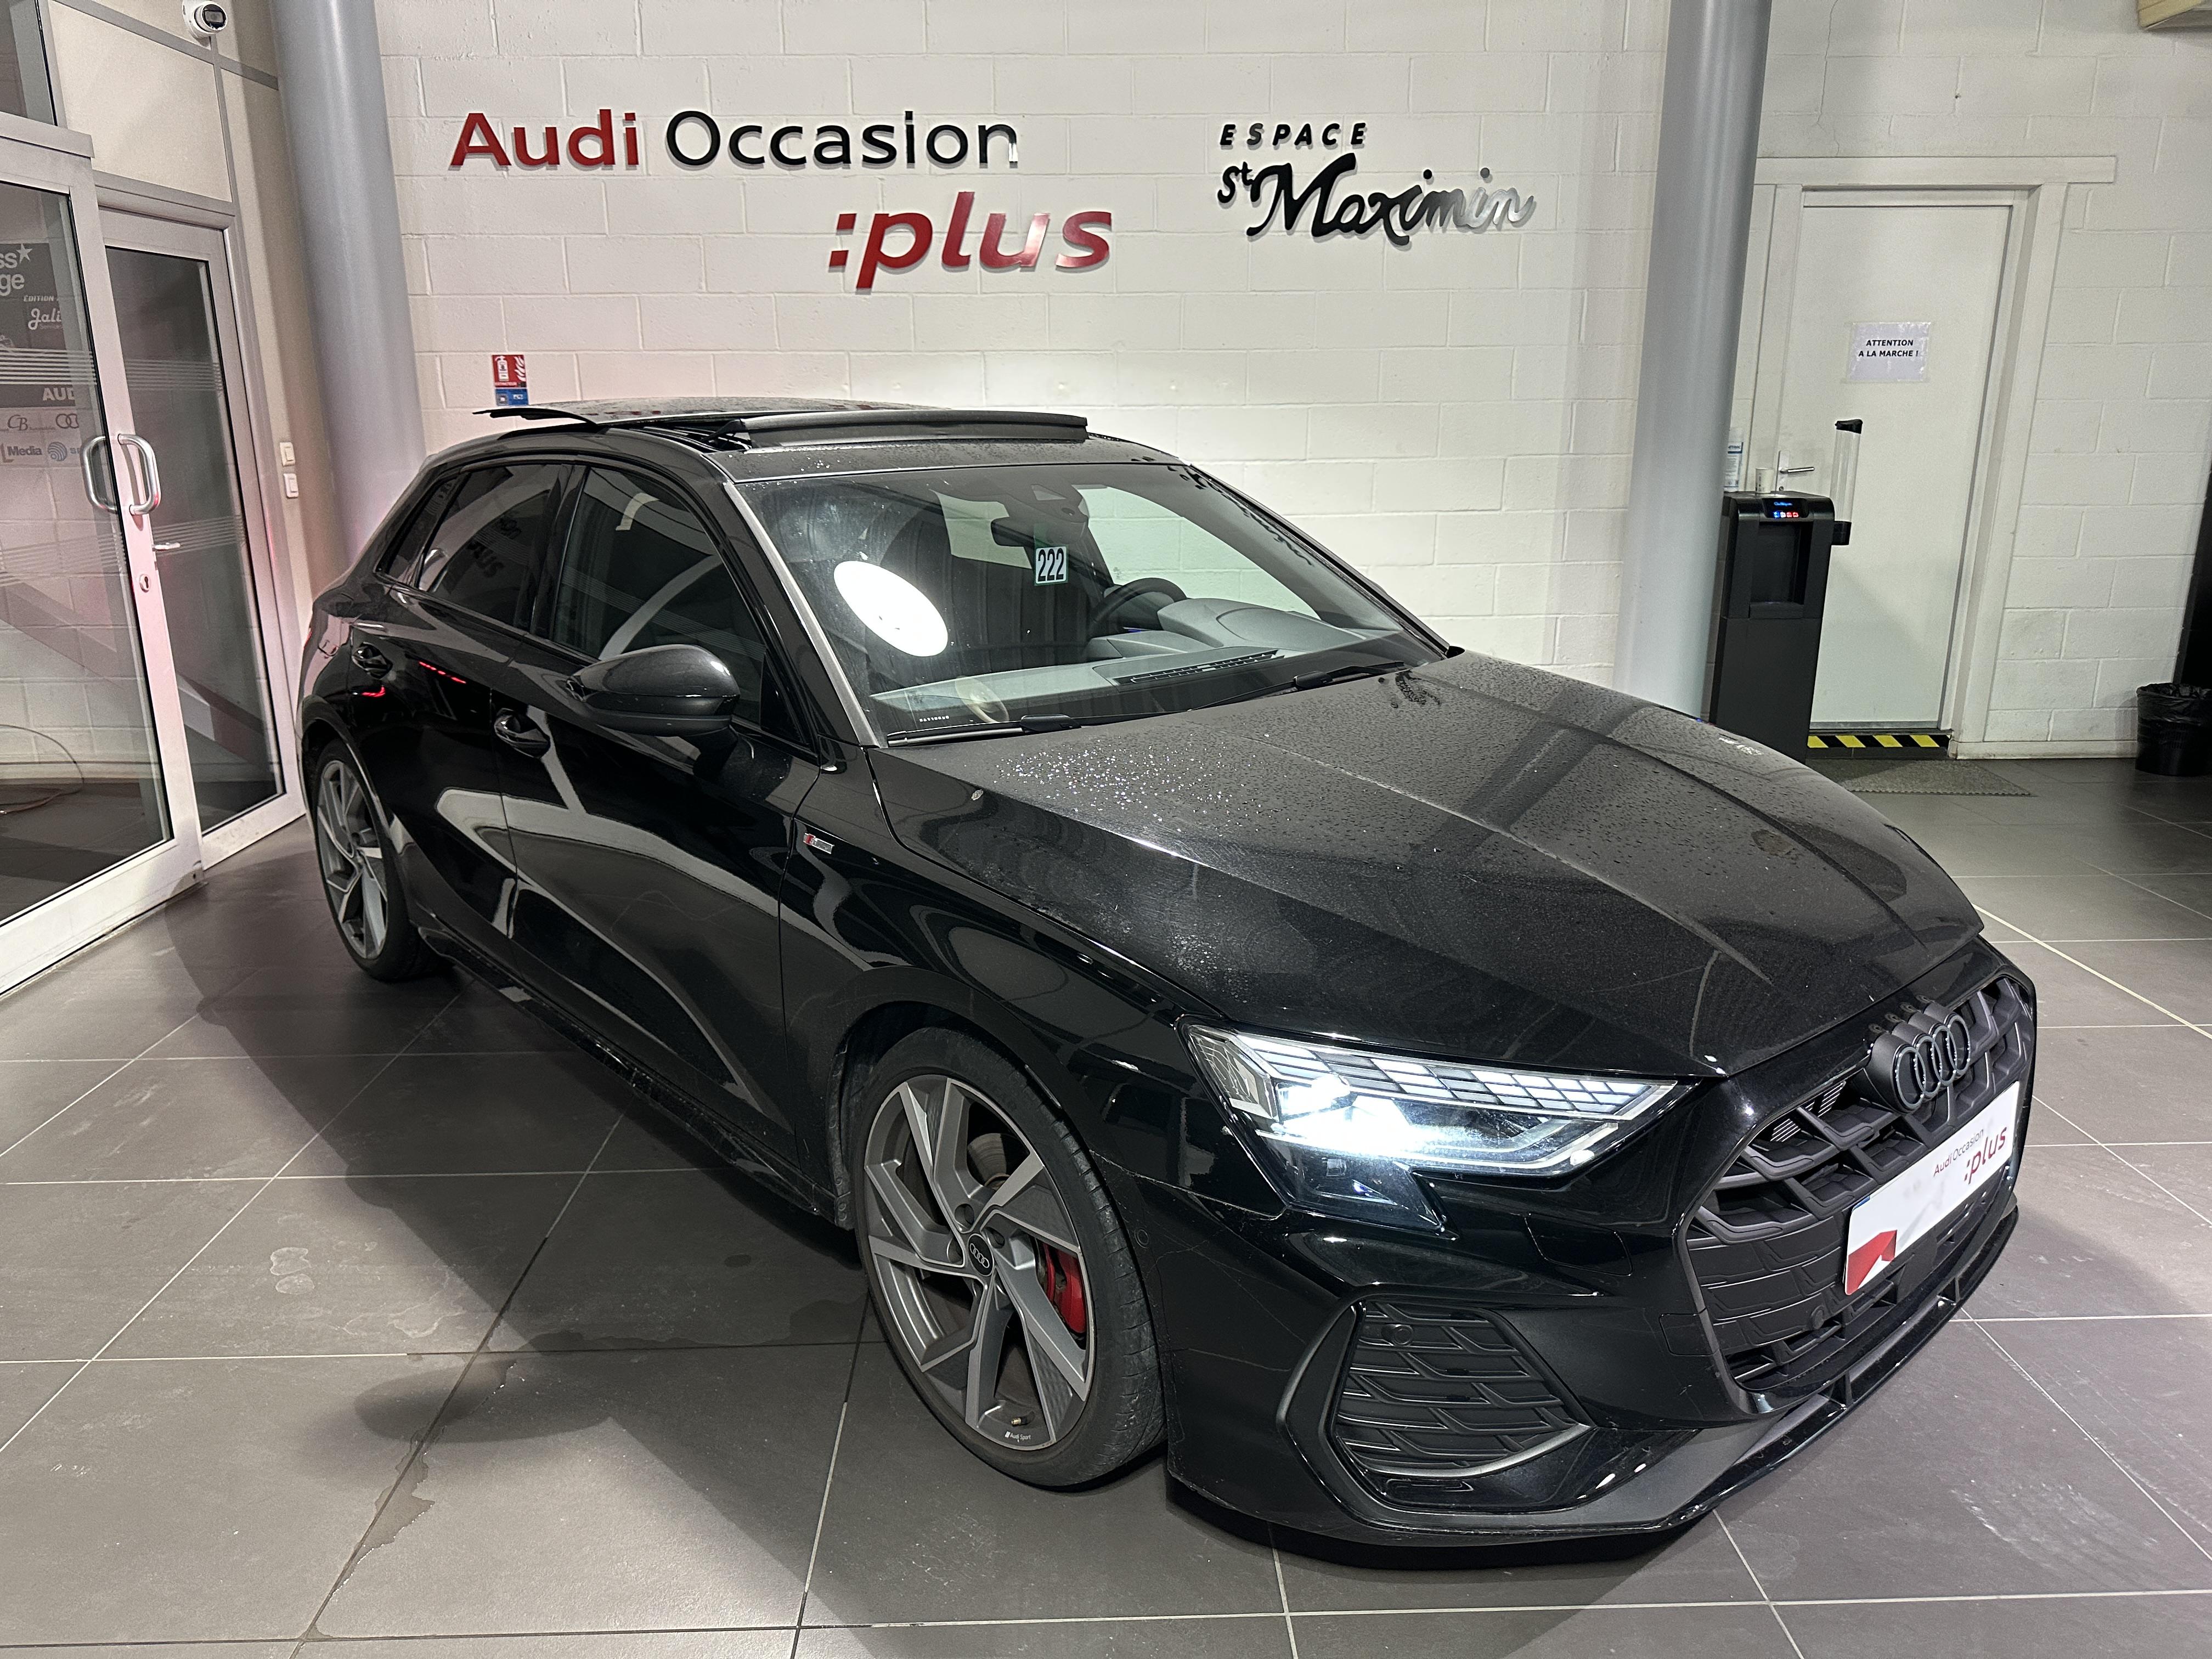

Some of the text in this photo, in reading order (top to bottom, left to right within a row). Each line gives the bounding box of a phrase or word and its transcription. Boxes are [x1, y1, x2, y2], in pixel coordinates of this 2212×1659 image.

[450, 109, 1018, 166] Audi Occasion
[1220, 122, 1366, 146] ESPACE
[1246, 153, 1534, 246] Maximin
[7, 445, 42, 456] Media
[1038, 548, 1064, 582] 222
[1933, 1129, 1984, 1177] Audi Occasion
